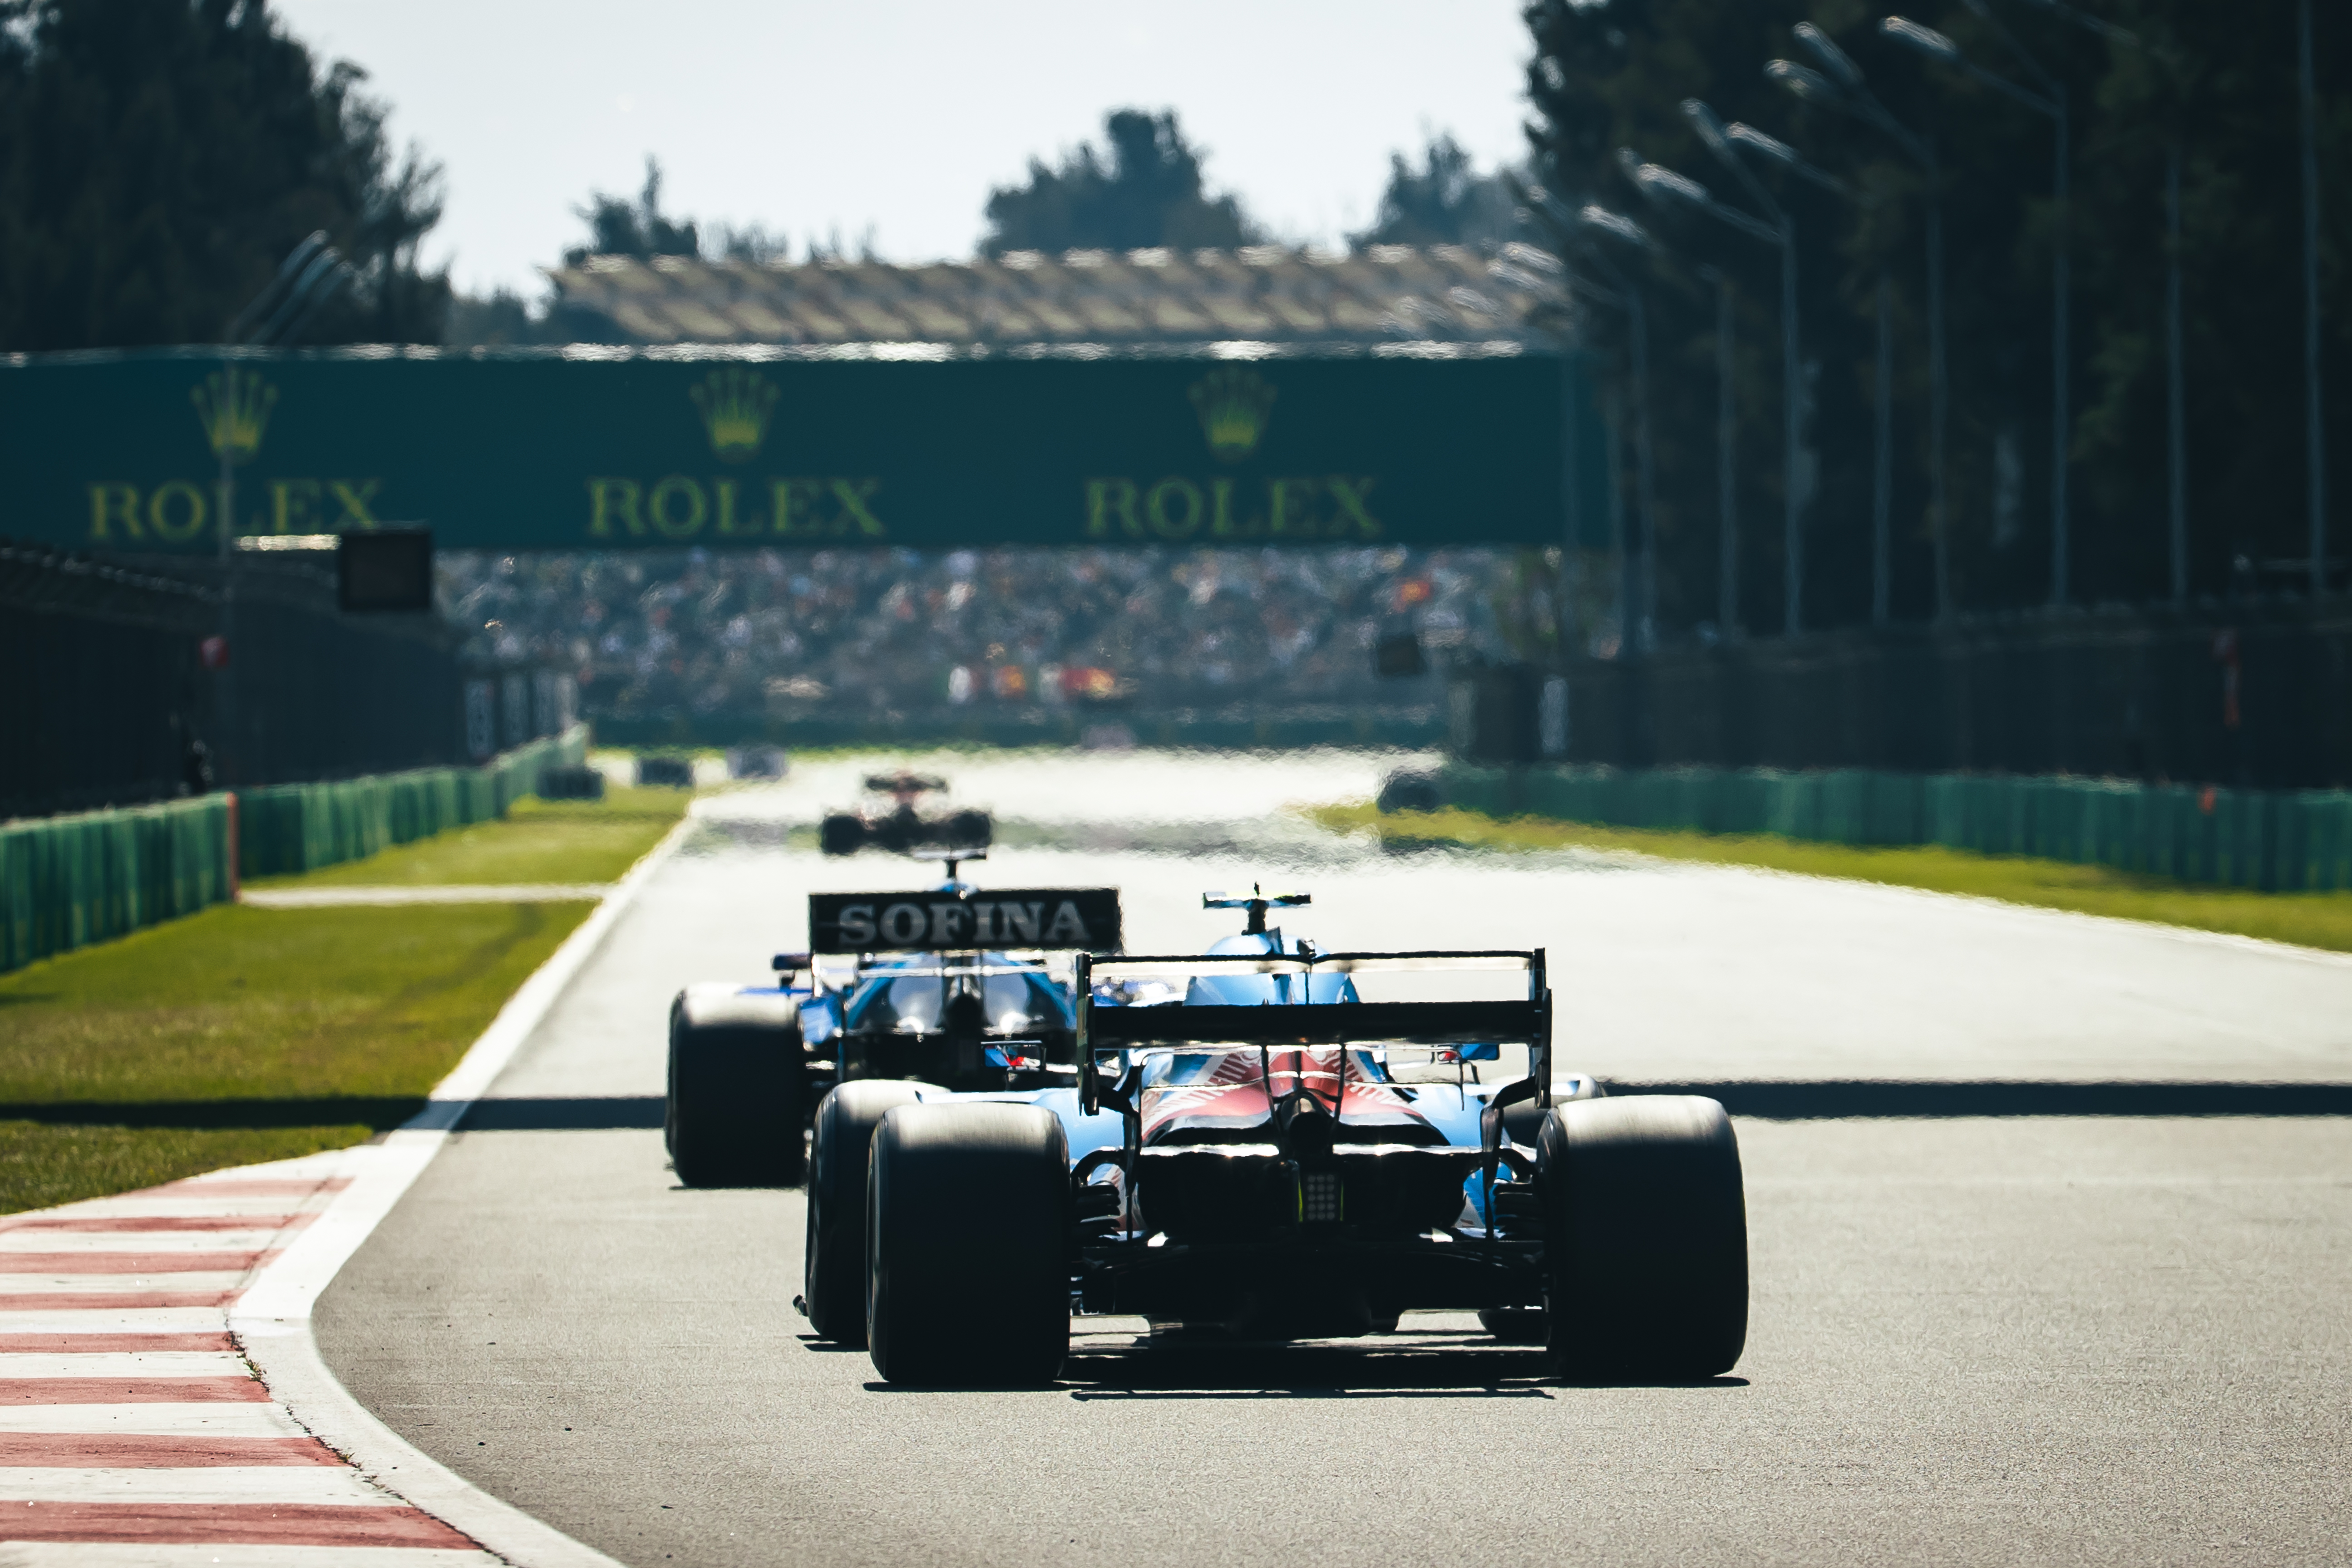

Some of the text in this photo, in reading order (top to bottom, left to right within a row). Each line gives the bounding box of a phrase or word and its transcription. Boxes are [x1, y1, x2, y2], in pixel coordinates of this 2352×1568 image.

[587, 476, 885, 537] ROLEX
[1085, 476, 1382, 537] ROLEX
[838, 901, 1090, 943] SOFINA
